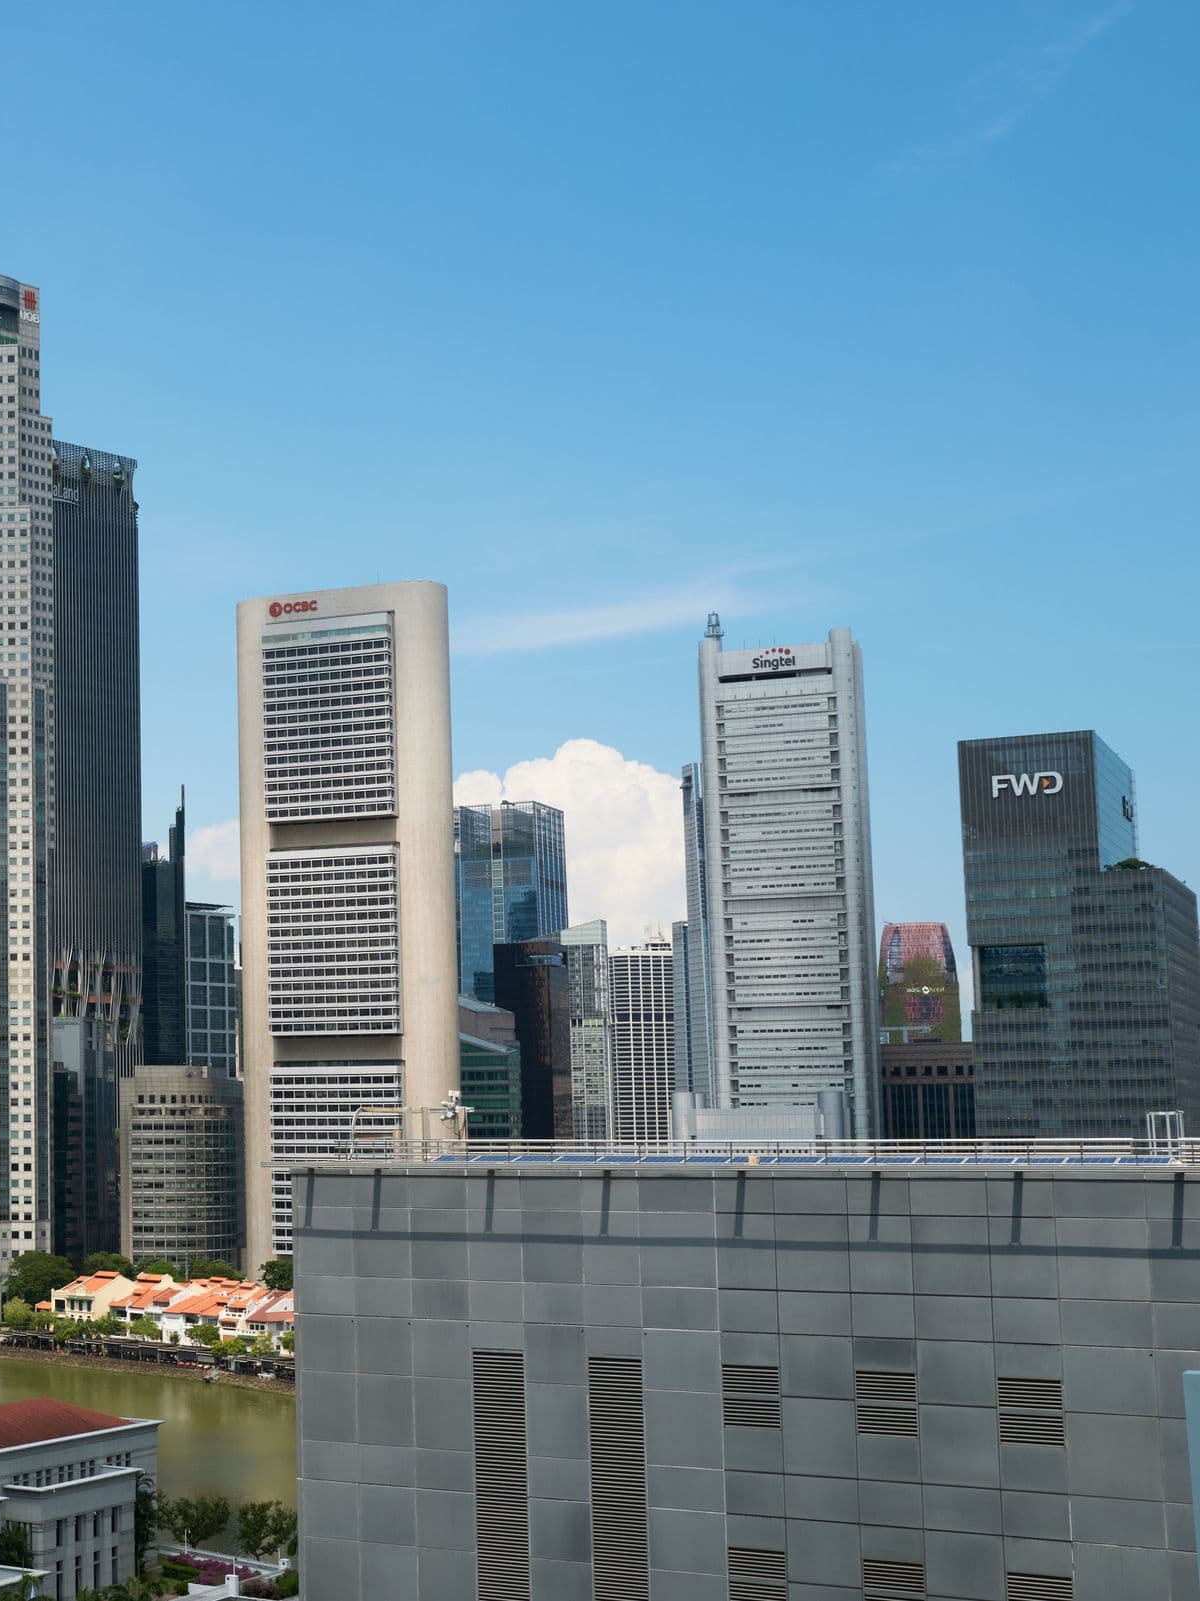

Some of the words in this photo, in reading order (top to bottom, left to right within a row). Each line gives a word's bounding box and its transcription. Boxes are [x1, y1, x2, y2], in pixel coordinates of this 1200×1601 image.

[19, 310, 39, 323] UOB
[283, 600, 318, 614] OCBC
[752, 655, 796, 670] Singtel
[991, 771, 1063, 798] FWD
